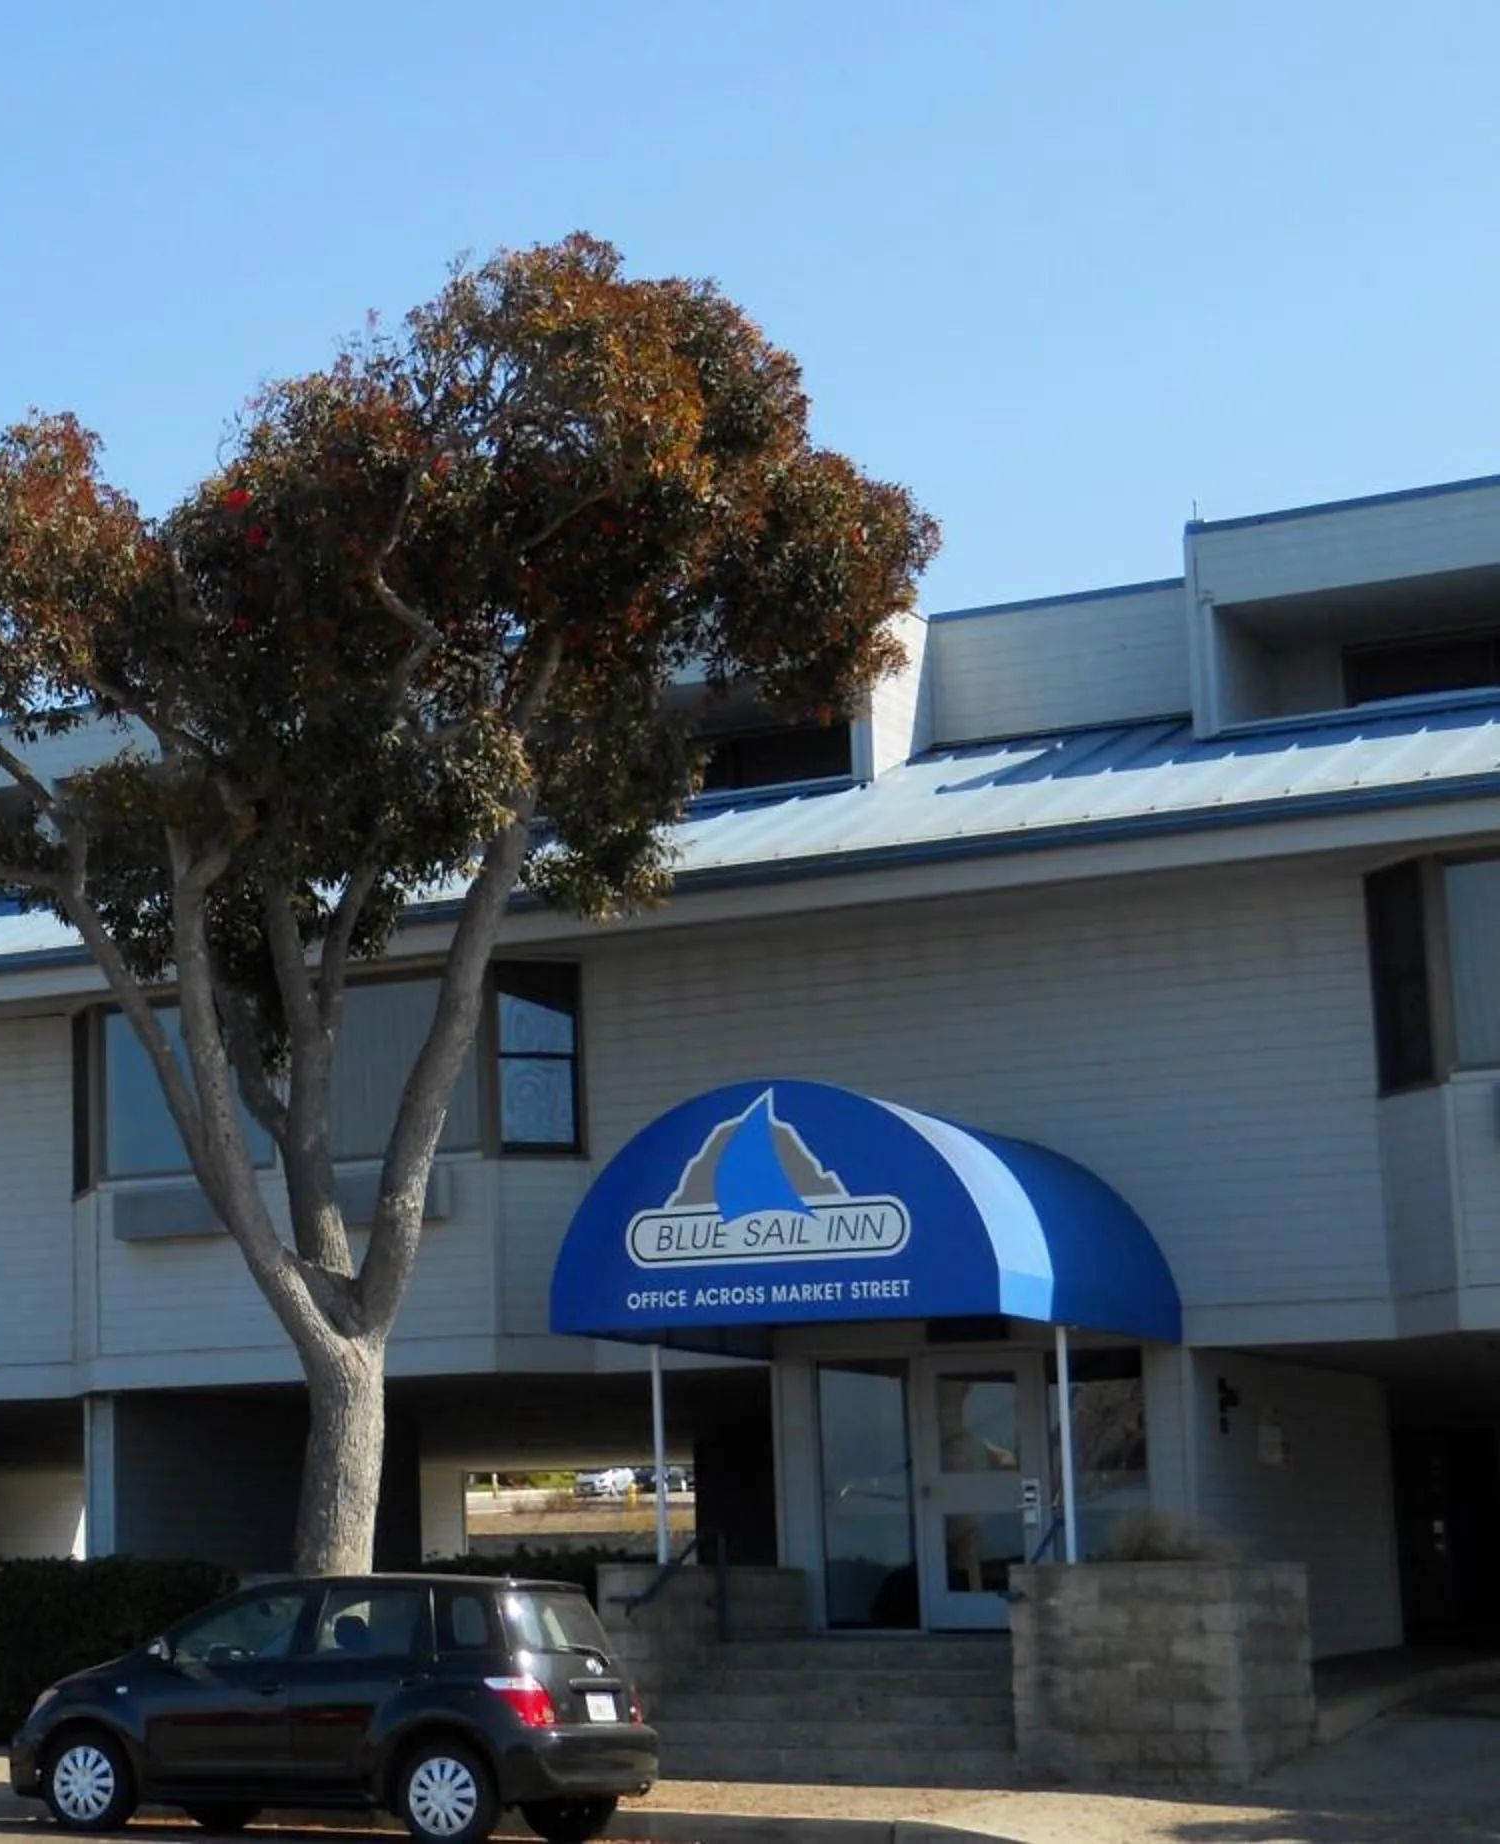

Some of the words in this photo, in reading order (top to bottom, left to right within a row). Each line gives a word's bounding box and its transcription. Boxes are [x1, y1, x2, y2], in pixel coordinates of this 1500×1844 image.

[656, 1222, 729, 1252] BLUE
[743, 1217, 811, 1247] SAIL
[826, 1211, 886, 1242] INN
[627, 1289, 687, 1310] OFFICE
[695, 1285, 765, 1306] ACROSS
[771, 1282, 842, 1303] MARKET
[850, 1279, 911, 1299] STREET
